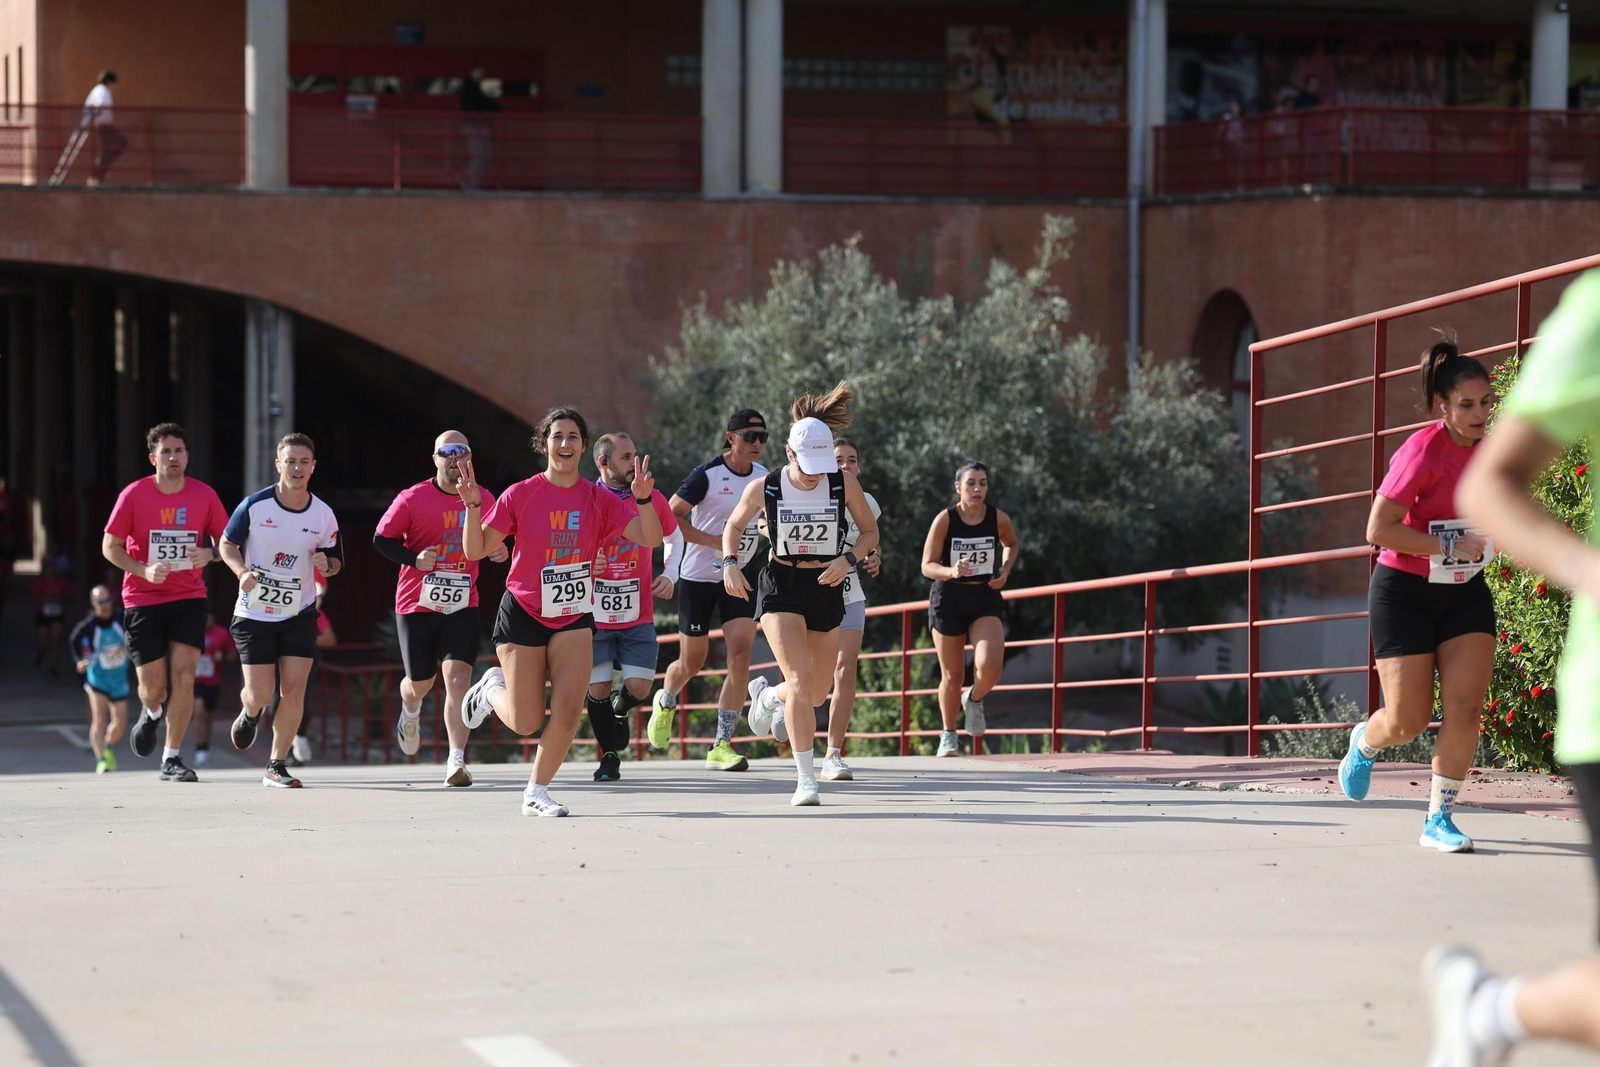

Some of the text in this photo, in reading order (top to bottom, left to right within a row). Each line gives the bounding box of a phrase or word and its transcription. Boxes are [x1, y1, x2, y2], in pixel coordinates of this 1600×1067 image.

[160, 507, 187, 525] WE
[549, 510, 580, 530] WE
[551, 532, 577, 547] RUN
[788, 524, 828, 541] 422
[157, 545, 187, 560] 531
[426, 577, 447, 585] UMA
[544, 574, 568, 583] UMA
[258, 586, 293, 605] 226
[430, 586, 463, 603] 656
[551, 580, 586, 604] 299
[595, 585, 616, 594] UMA
[601, 594, 633, 611] 681
